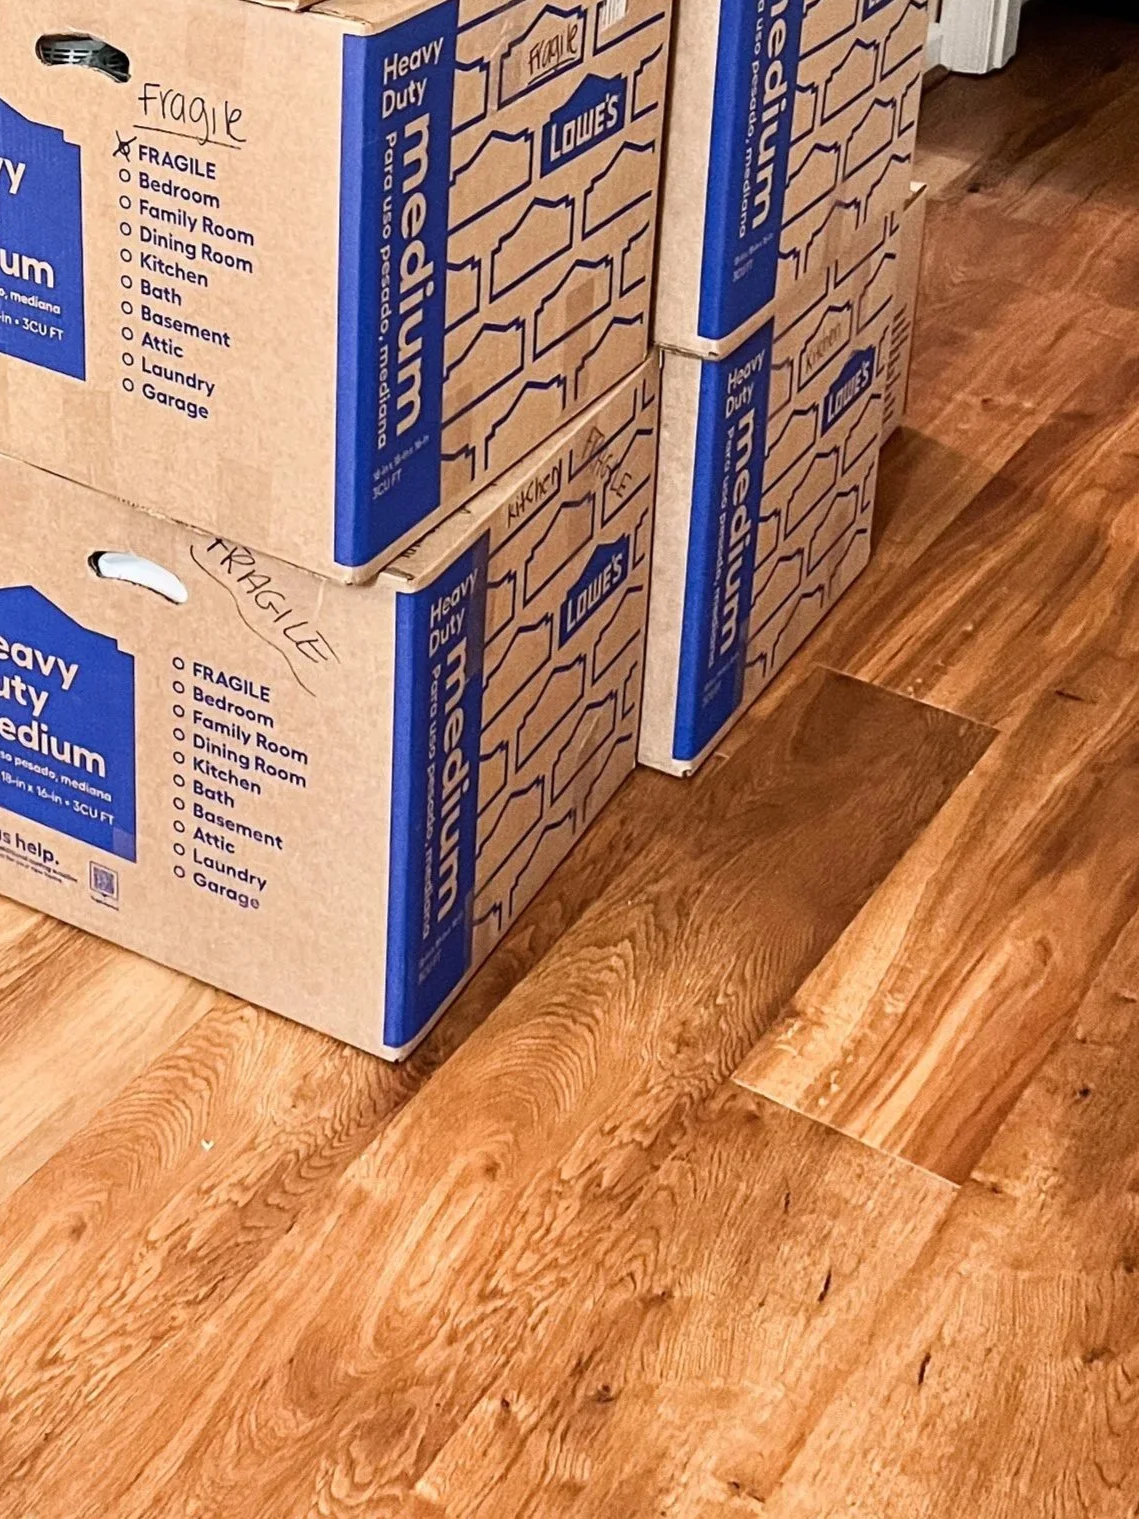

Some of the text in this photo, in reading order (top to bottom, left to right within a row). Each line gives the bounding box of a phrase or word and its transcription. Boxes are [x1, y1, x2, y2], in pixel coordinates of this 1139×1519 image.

[528, 24, 578, 75] Fragile
[754, 17, 764, 54] uso
[384, 36, 444, 85] Heavy
[138, 83, 246, 145] Fragile
[382, 77, 428, 120] Duty
[746, 61, 760, 143] pesado,
[550, 92, 620, 162] LOWE'S
[138, 144, 216, 180] FRAGILE
[139, 172, 220, 209] Bedroom
[739, 147, 753, 238] mediana
[140, 199, 254, 246] Family Room
[140, 226, 253, 274] Dining Room
[140, 252, 208, 288] Kitchen
[140, 278, 182, 306] Bath
[378, 132, 397, 450] Para uso pesado, mediana
[396, 112, 434, 437] medium
[10, 290, 61, 314] mediana
[141, 304, 231, 348] Basement
[142, 332, 184, 358] Attic
[142, 356, 216, 397] Laundry
[728, 348, 765, 394] Heavy
[142, 383, 209, 419] Garage
[726, 382, 754, 419] Duty
[720, 408, 755, 656] medium
[430, 568, 478, 629] Heavy
[567, 552, 624, 633] LOWE'S
[429, 608, 465, 658] Duty
[193, 662, 270, 704] FRAGILE
[193, 686, 274, 729] Bedroom
[193, 710, 308, 765] Family Room
[14, 755, 59, 782] pesado,
[60, 774, 112, 804] mediana
[193, 734, 306, 788] Dining Room
[193, 756, 261, 796] Kitchen
[437, 636, 470, 922] medium
[193, 780, 235, 809] Bath
[192, 826, 236, 854] Attic
[193, 802, 284, 850] Basement
[15, 832, 60, 866] help.
[193, 848, 268, 892] Laundry
[193, 872, 260, 910] Garage
